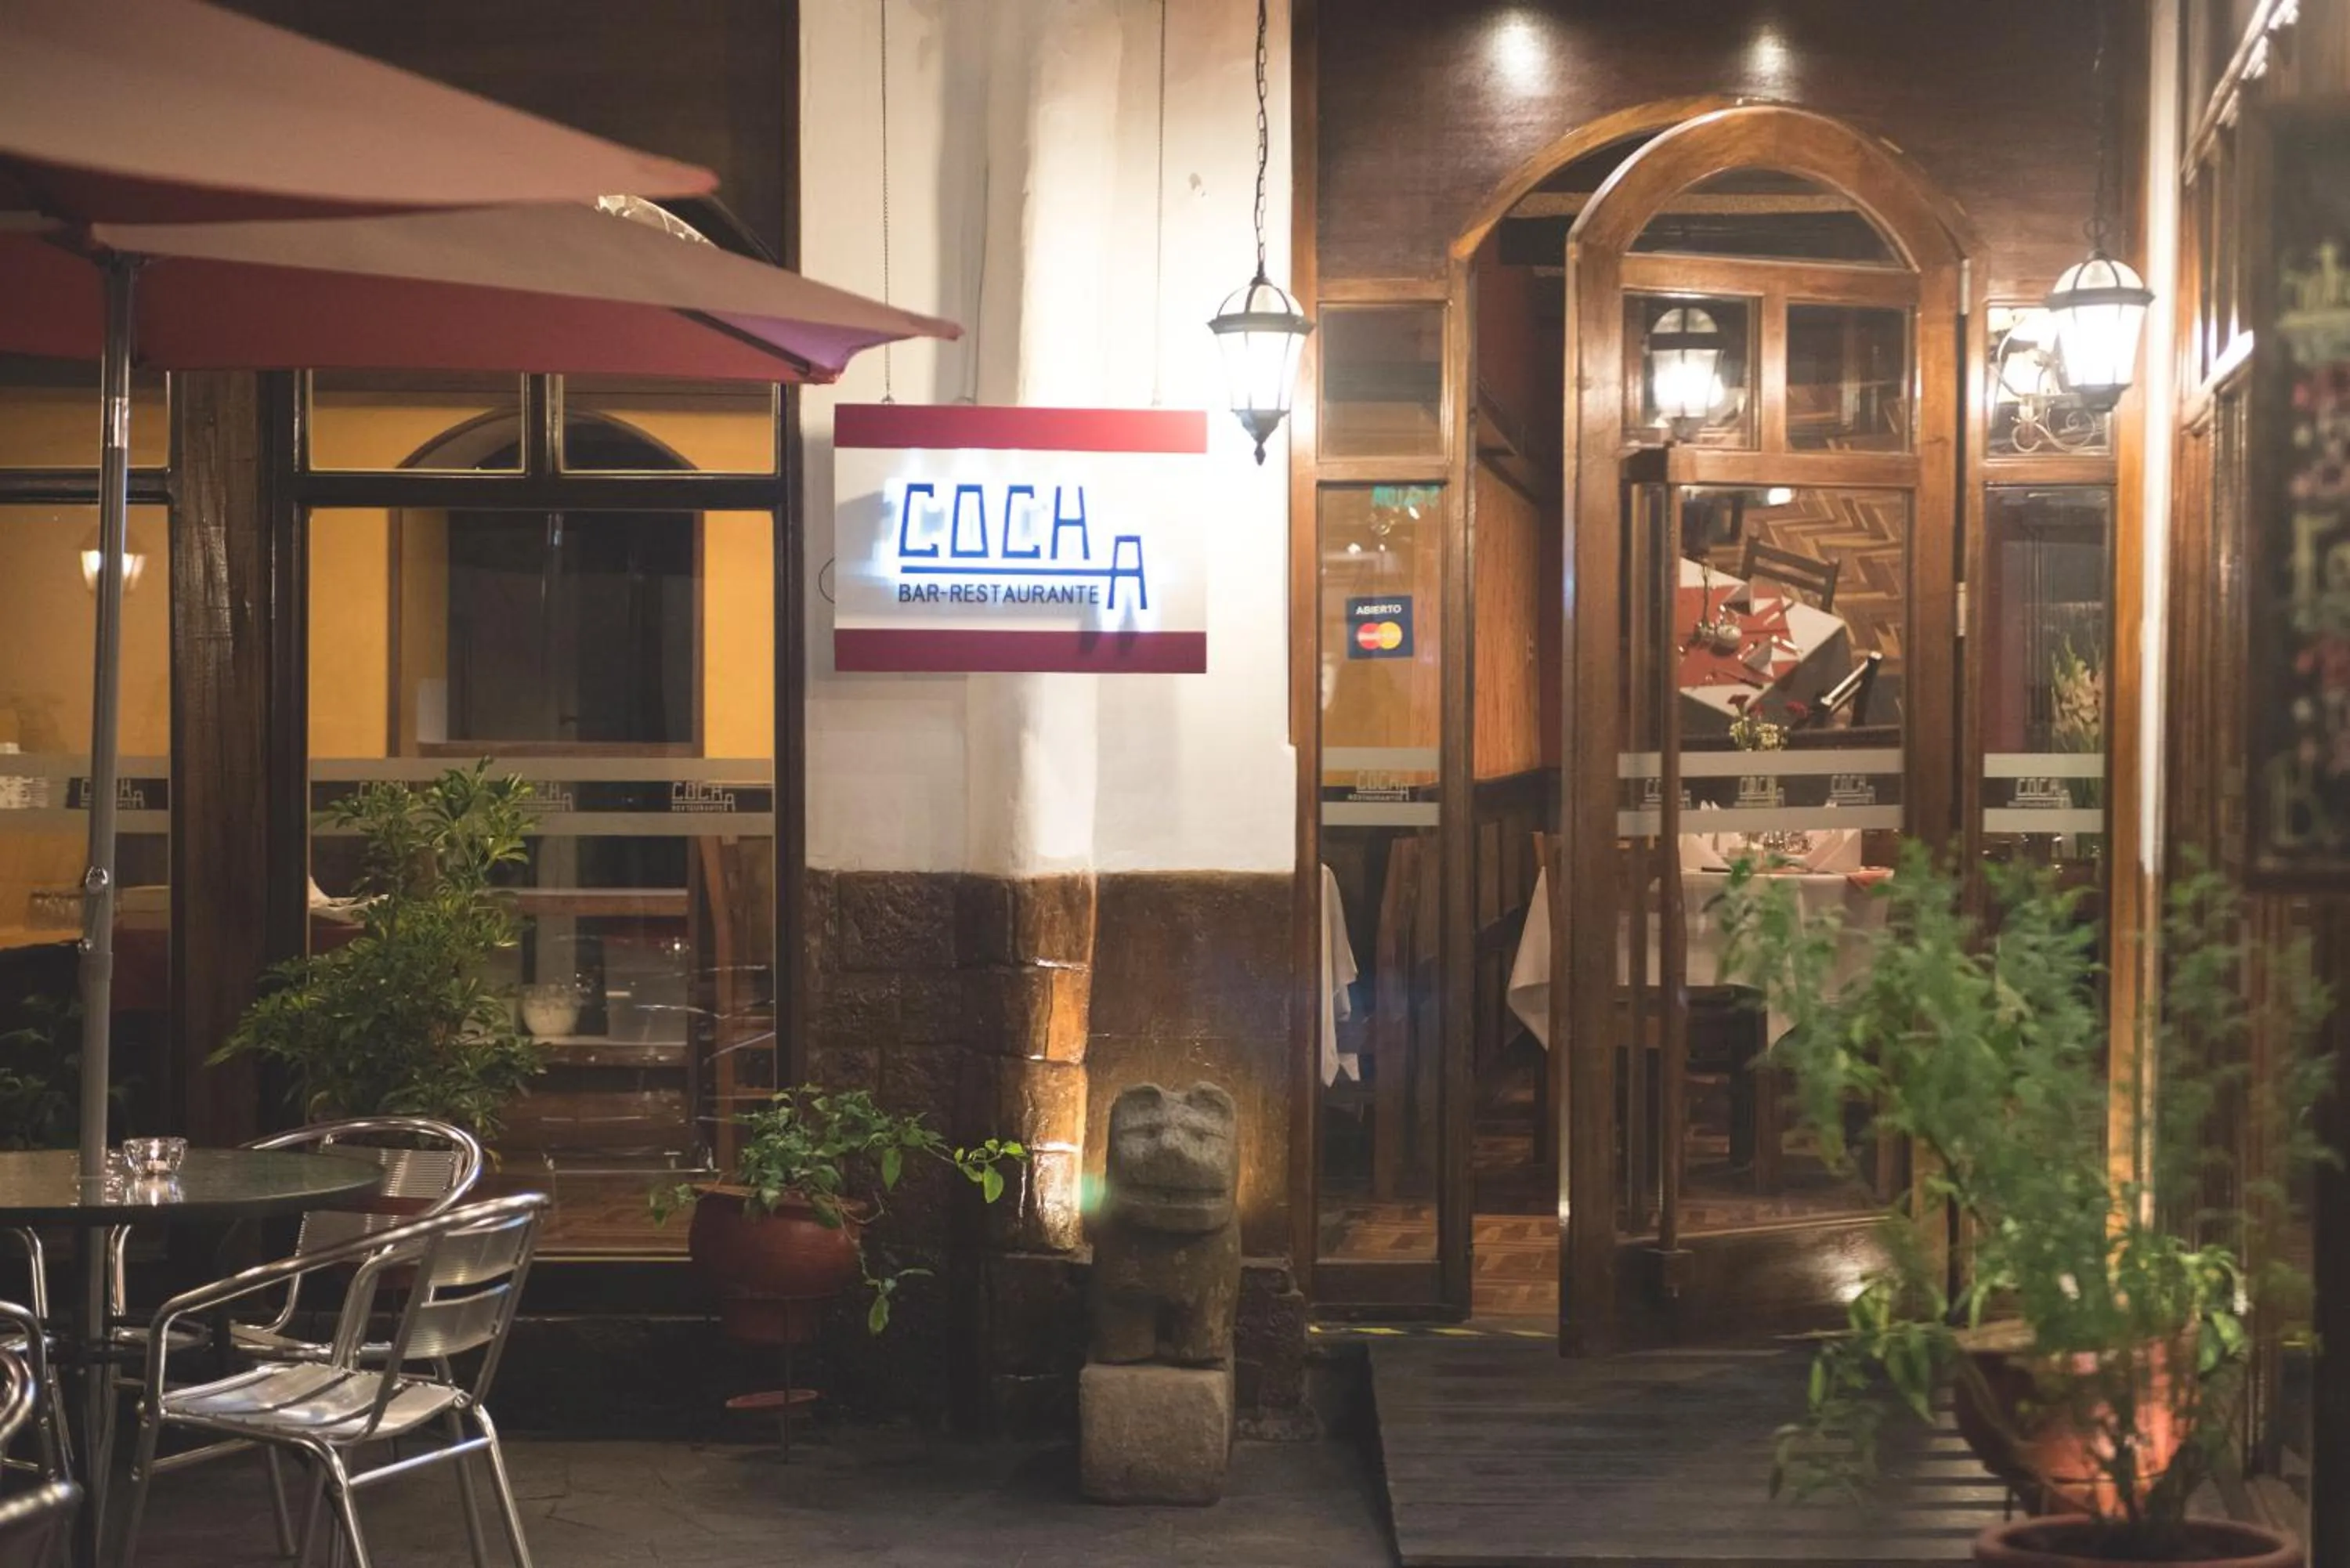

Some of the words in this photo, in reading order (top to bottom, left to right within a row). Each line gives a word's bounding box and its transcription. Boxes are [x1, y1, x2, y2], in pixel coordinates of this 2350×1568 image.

[898, 482, 1148, 610] COCHA
[898, 583, 1100, 605] BAR-RESTAURANTE
[1355, 604, 1403, 615] ABIERTO
[672, 782, 736, 812] COCHA
